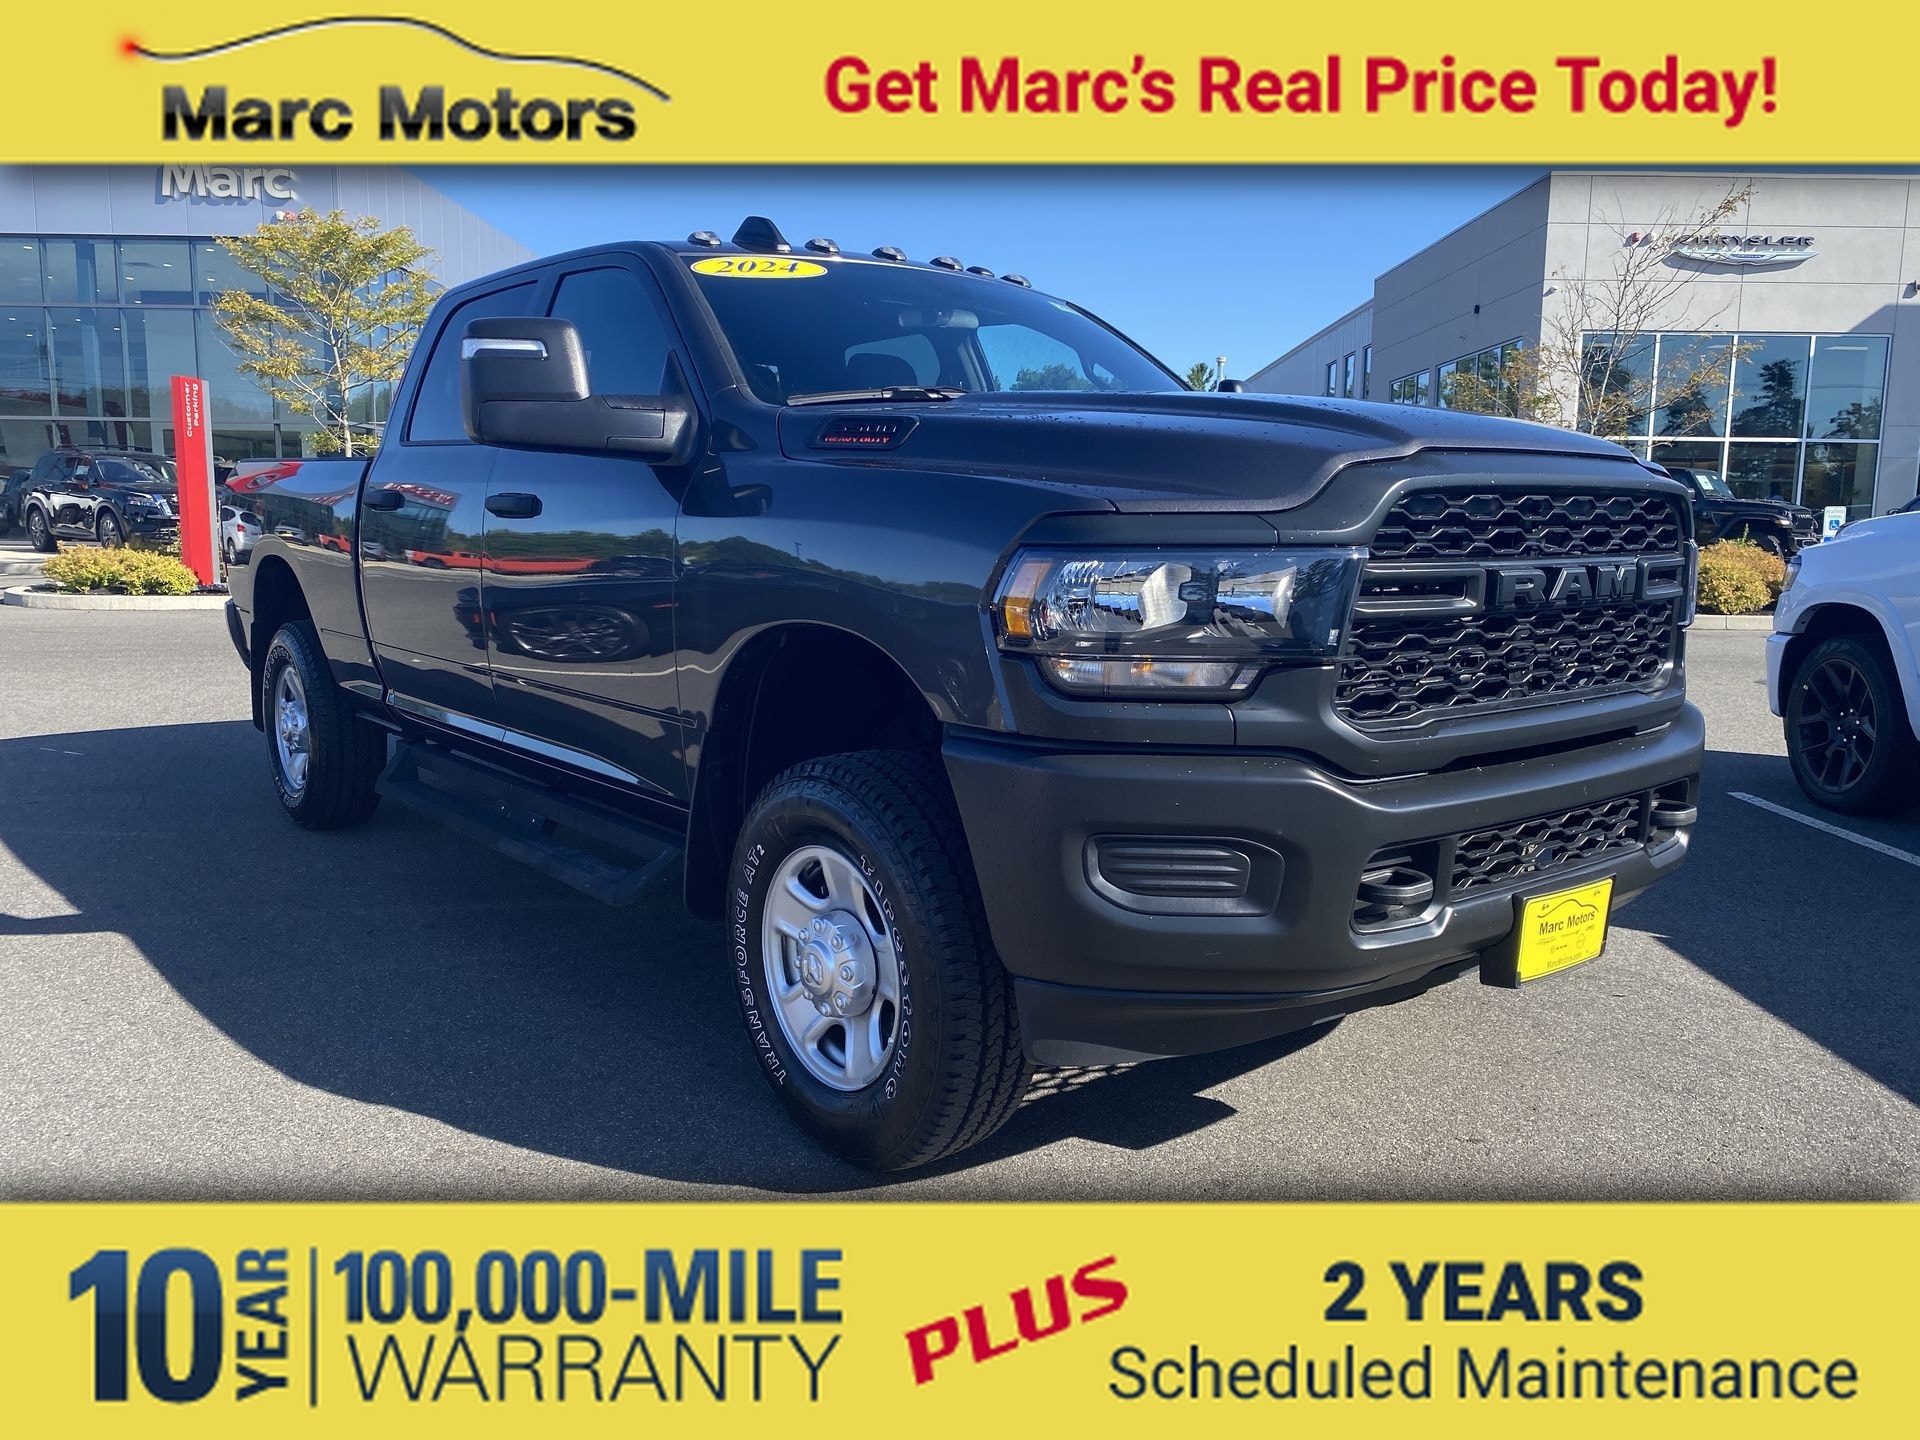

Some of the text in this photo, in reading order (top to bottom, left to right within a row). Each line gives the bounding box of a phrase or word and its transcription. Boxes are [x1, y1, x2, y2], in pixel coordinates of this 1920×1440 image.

[161, 162, 292, 199] Marc
[1679, 234, 1815, 247] CHRYSLER
[715, 260, 798, 273] 2024
[184, 382, 193, 438] Customer
[192, 383, 200, 427] Parking
[1496, 564, 1638, 606] RAM
[1539, 910, 1596, 937] Marc Motors
[733, 888, 787, 1086] TRANSFORCE
